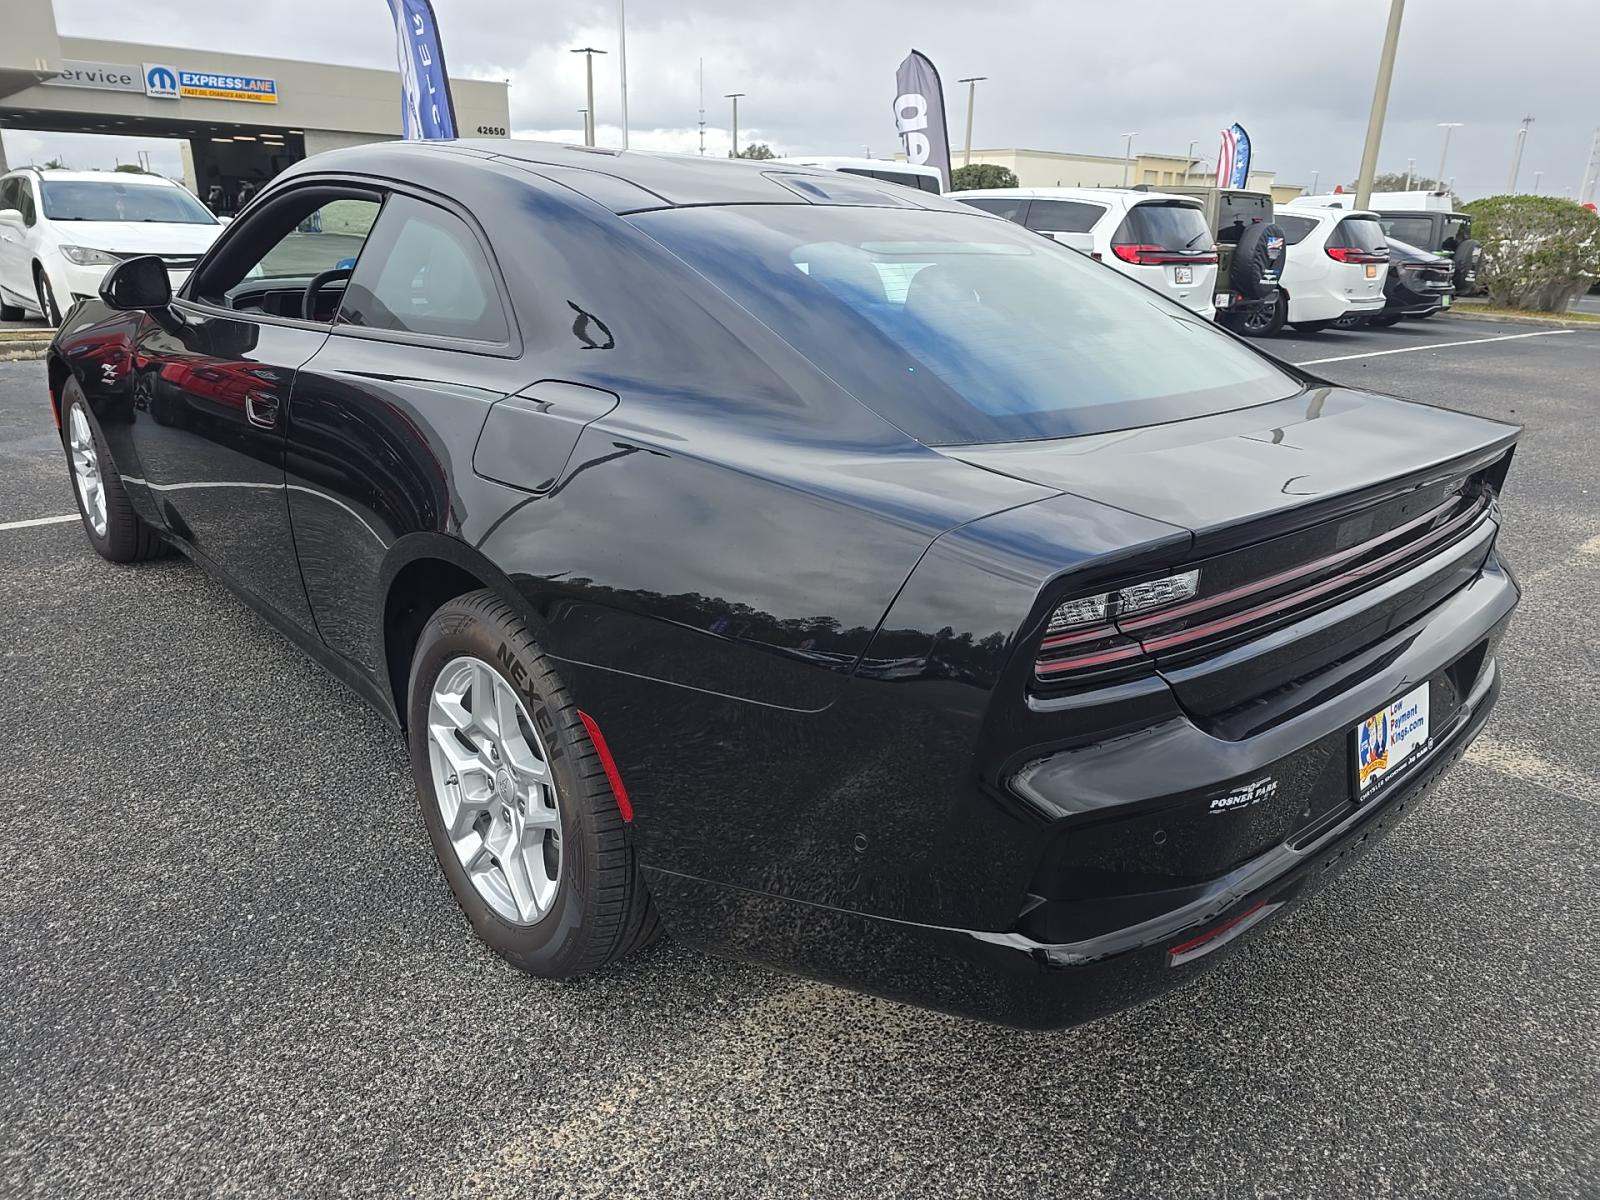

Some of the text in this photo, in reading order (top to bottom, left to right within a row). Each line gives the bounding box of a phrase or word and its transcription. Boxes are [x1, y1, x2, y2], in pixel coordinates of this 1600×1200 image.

[60, 67, 132, 86] ervice
[477, 126, 506, 136] 42650
[496, 642, 564, 761] NEXEN
[1390, 699, 1403, 716] Low
[1390, 704, 1418, 731] Payment
[1390, 716, 1424, 746] Kings.com
[1209, 792, 1254, 809] POSNER
[1255, 780, 1279, 798] PARK
